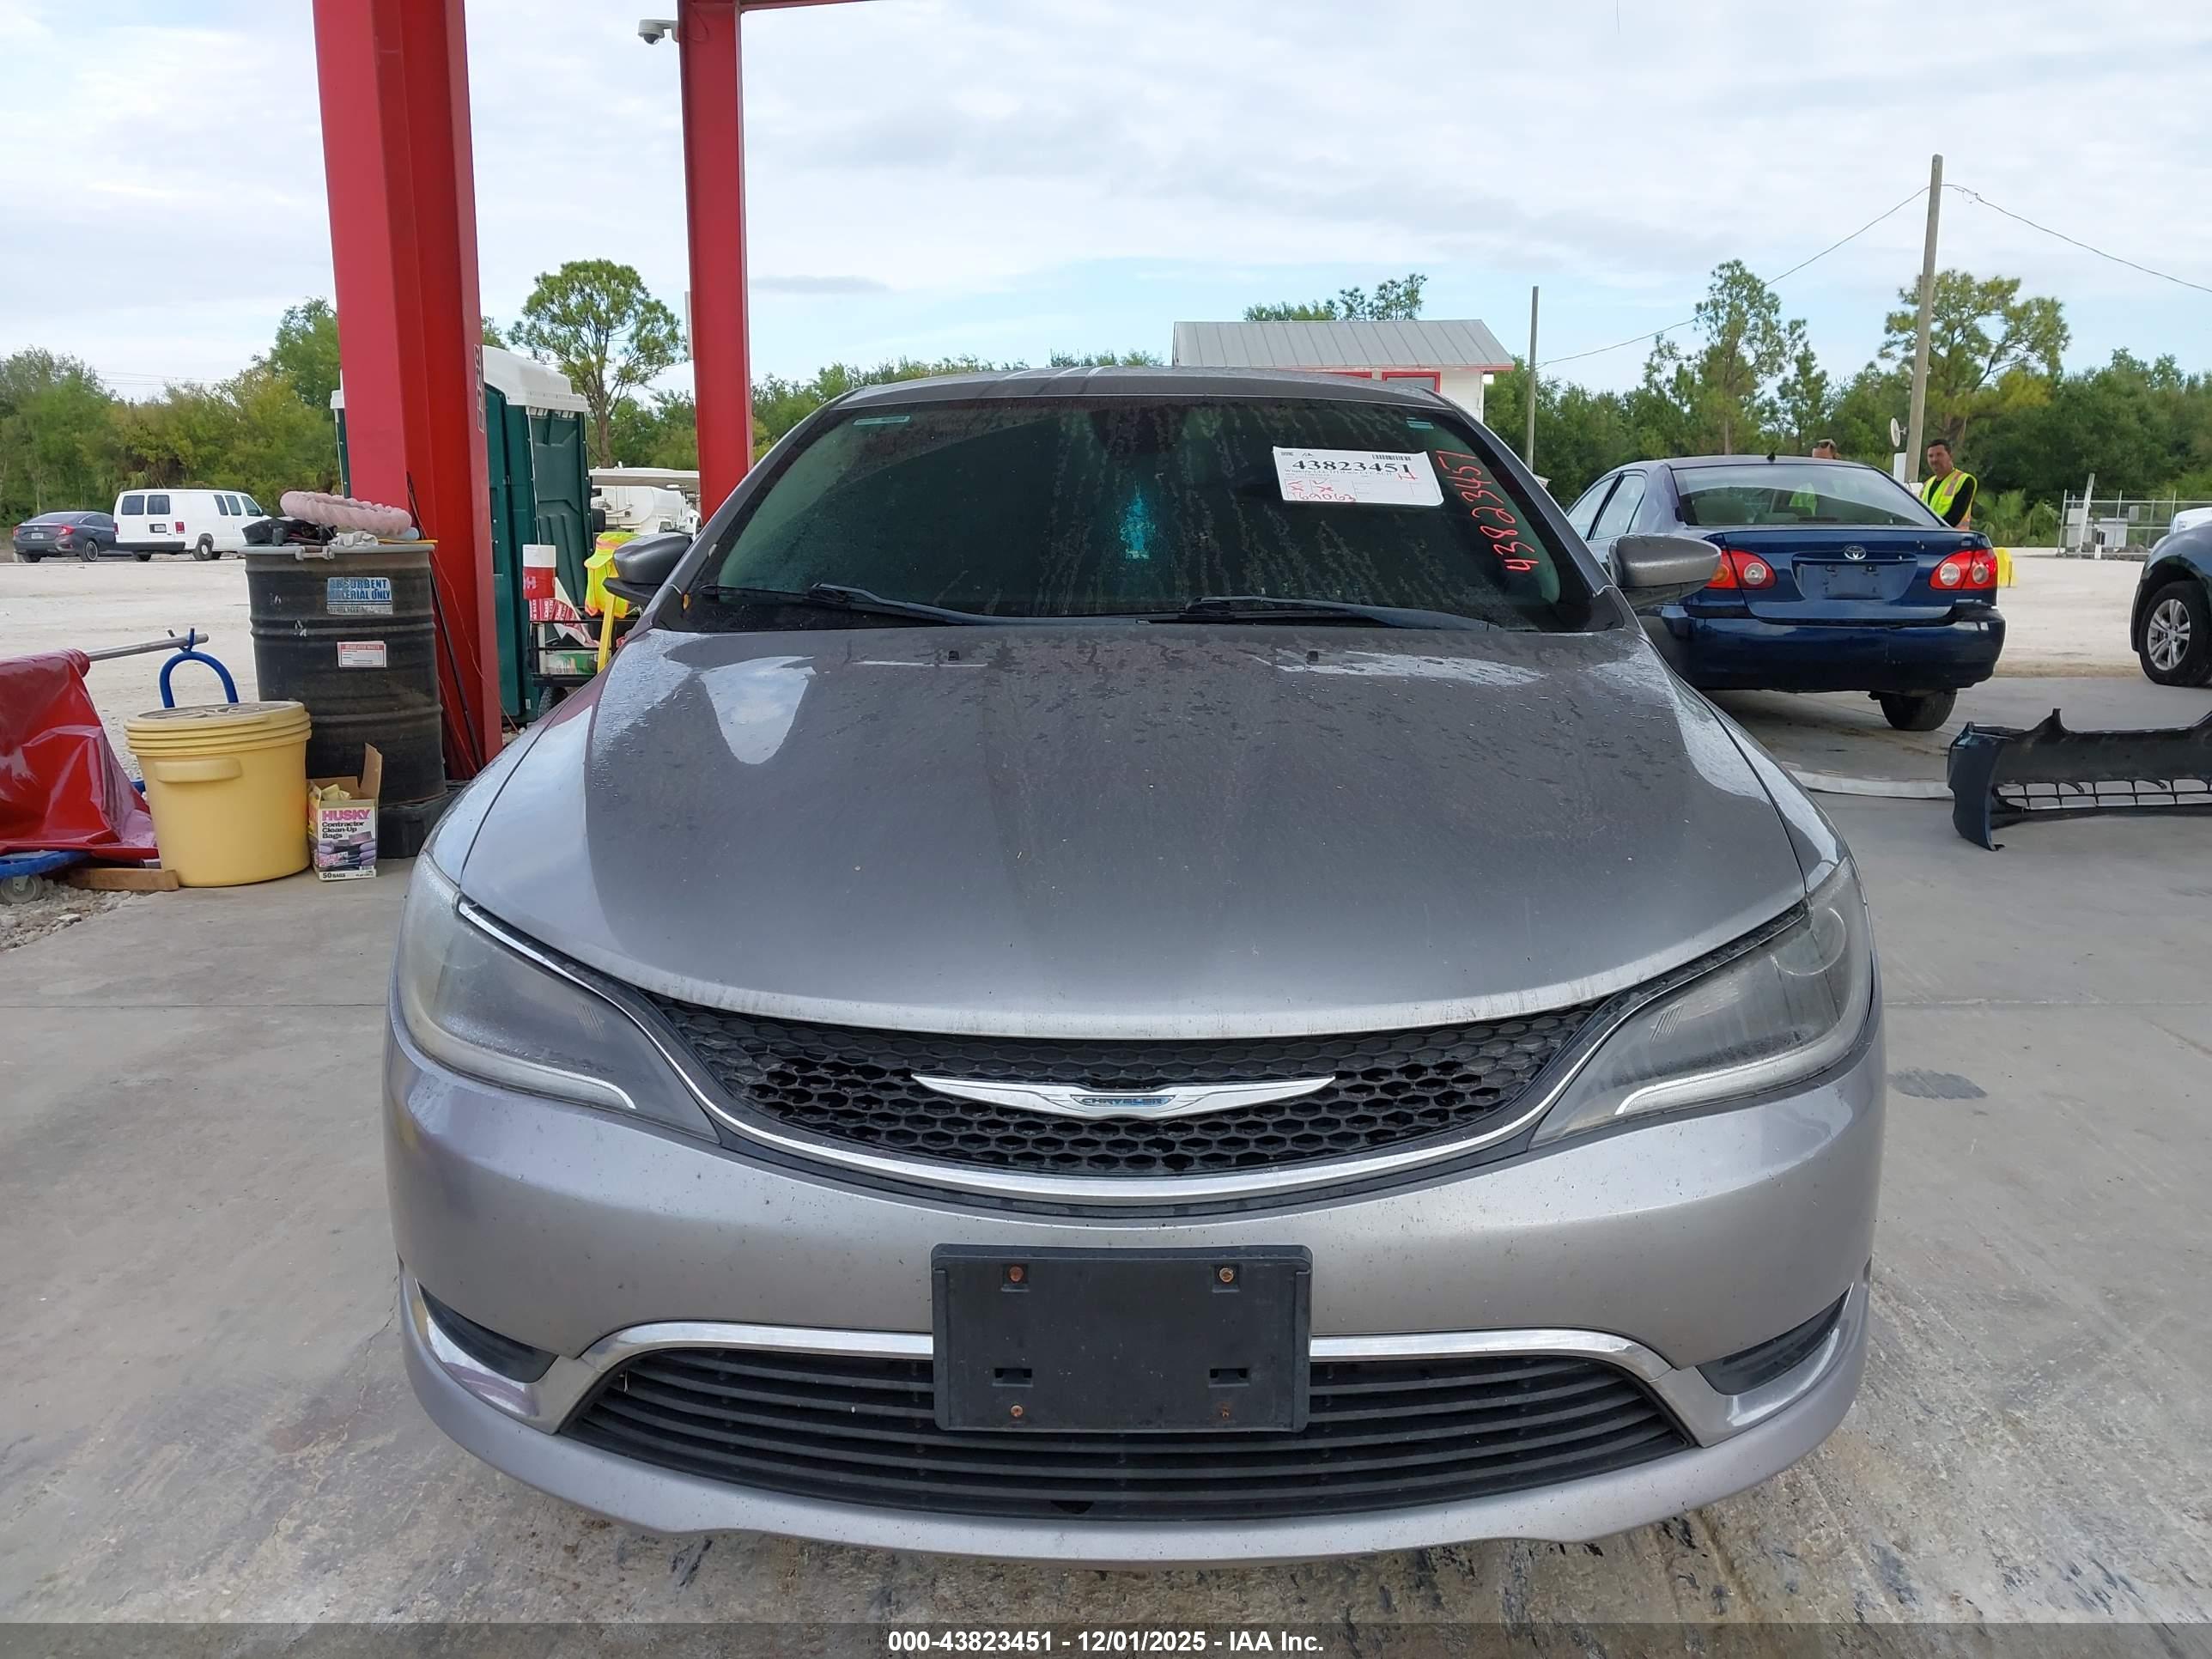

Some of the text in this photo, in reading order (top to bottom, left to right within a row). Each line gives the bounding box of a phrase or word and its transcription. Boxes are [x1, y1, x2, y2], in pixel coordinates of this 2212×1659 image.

[1291, 459, 1409, 473] 43823451
[371, 590, 391, 600] ONLY
[322, 810, 371, 821] HUSKY
